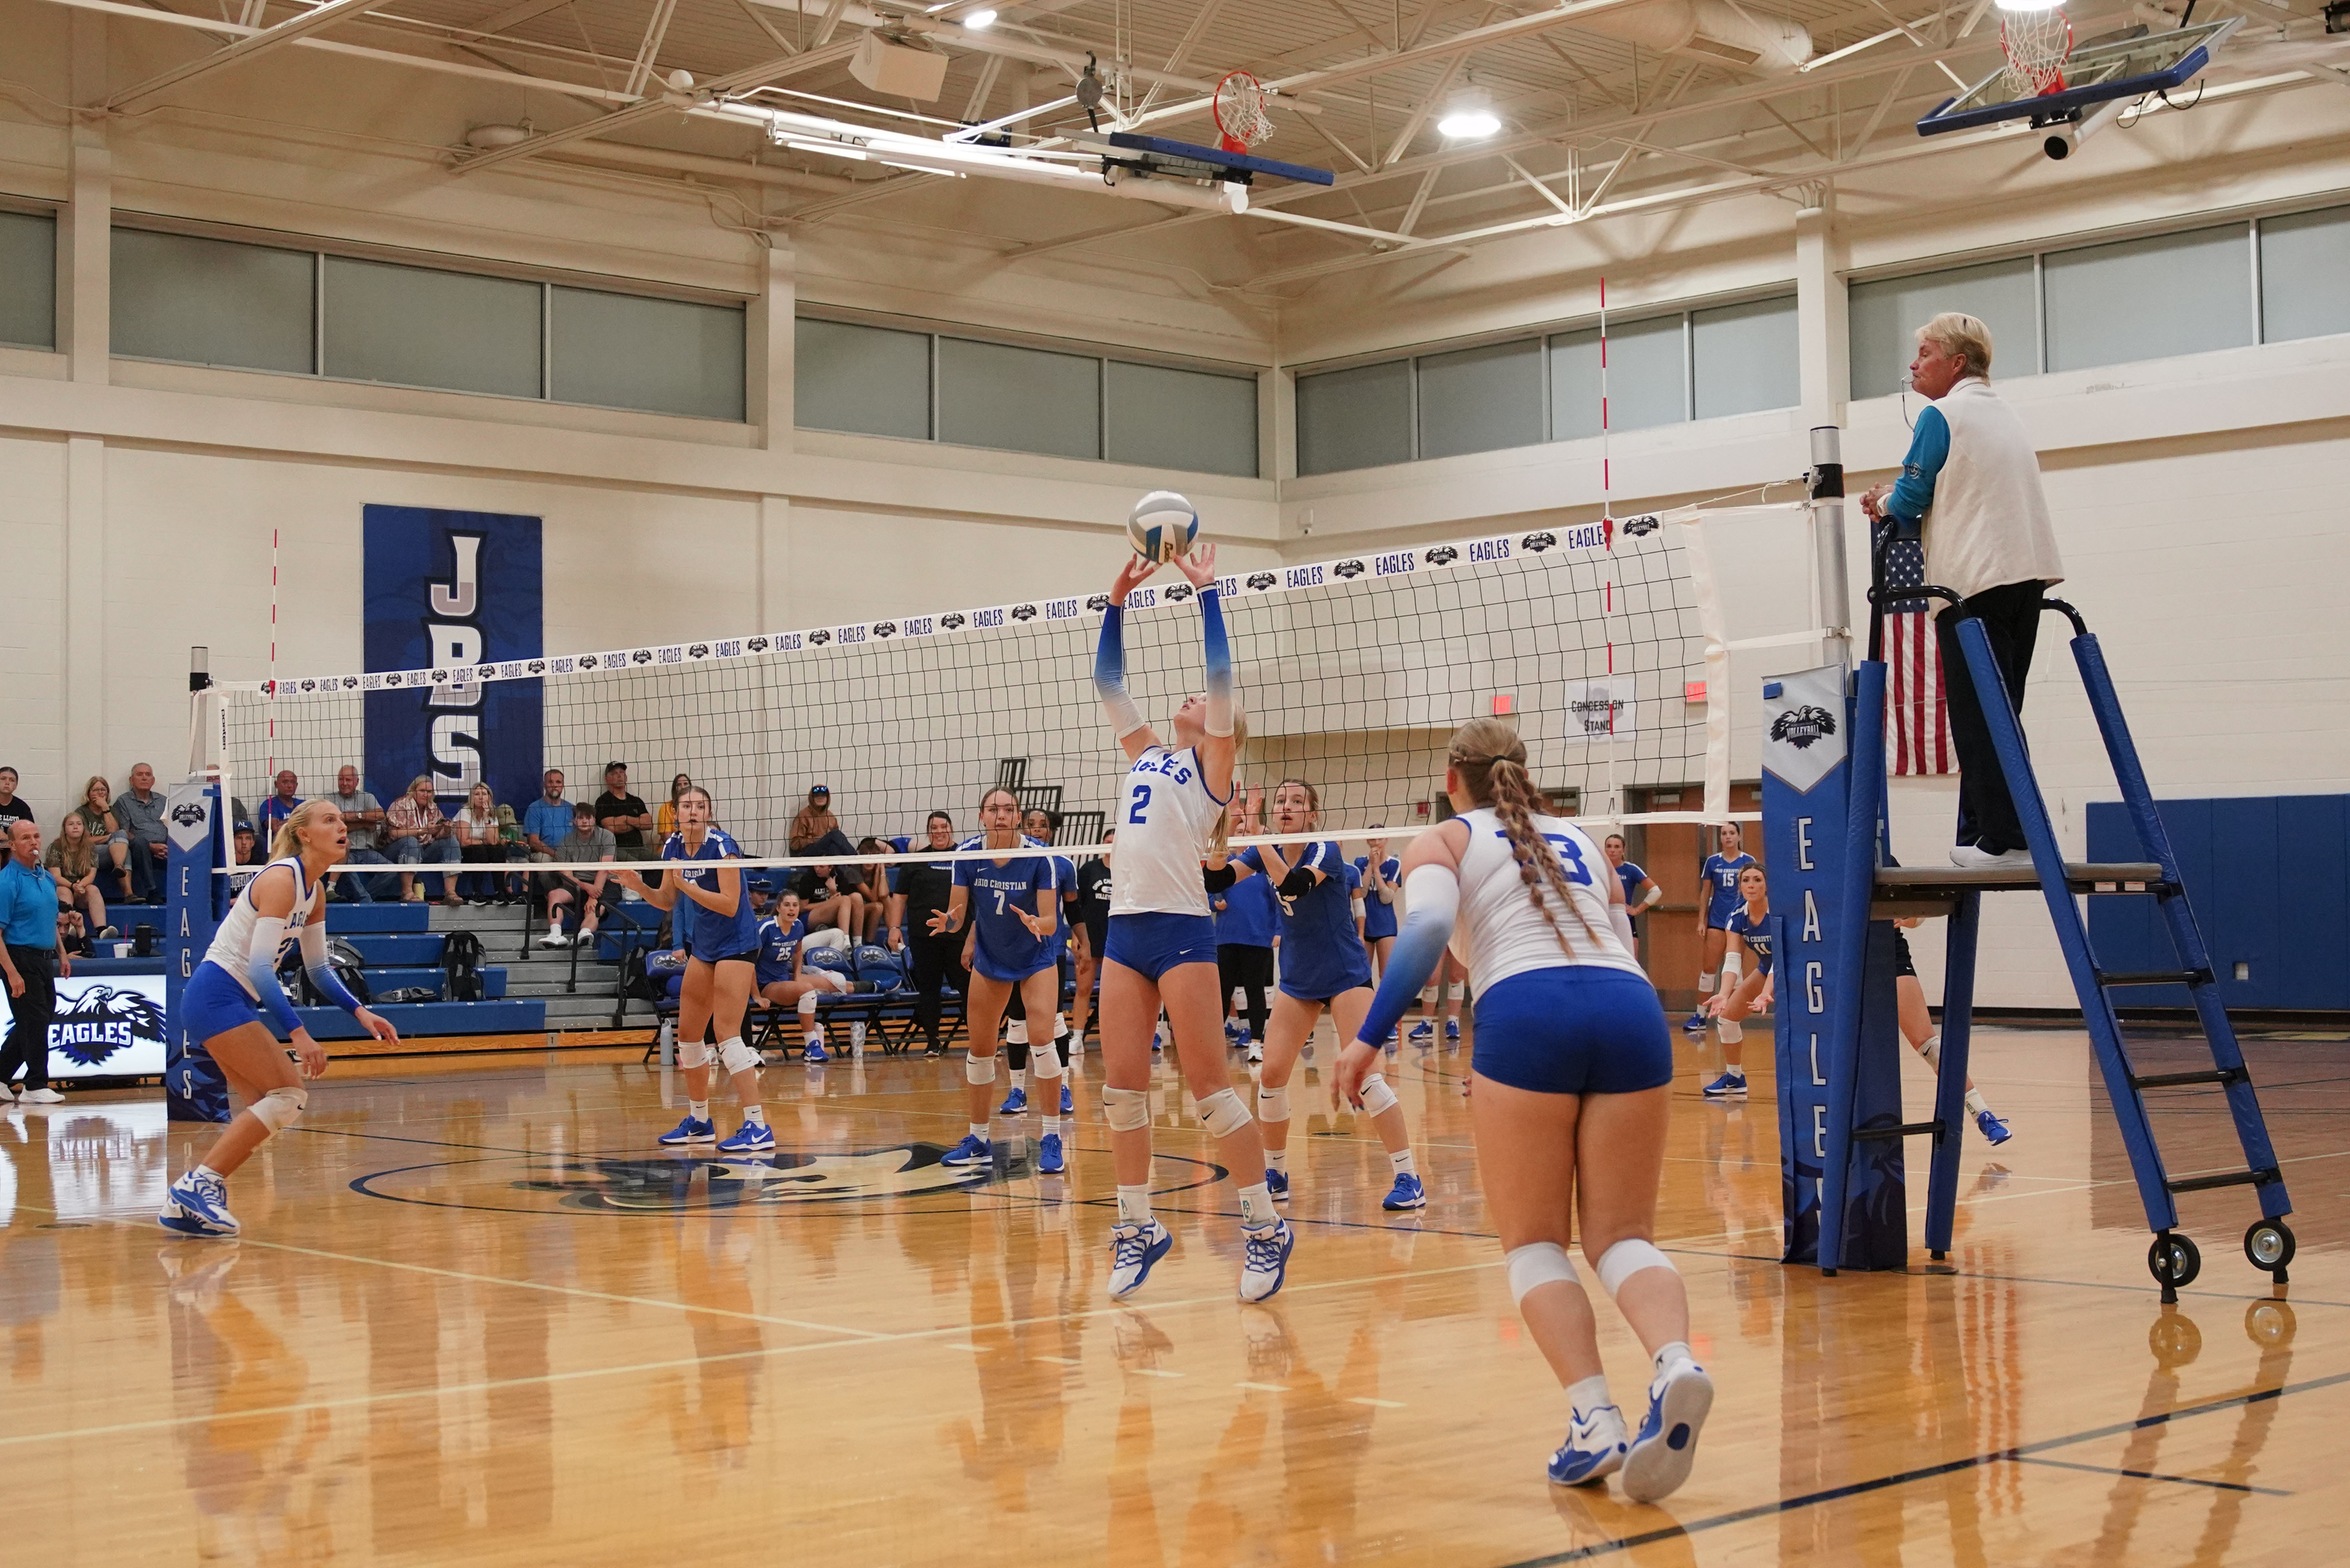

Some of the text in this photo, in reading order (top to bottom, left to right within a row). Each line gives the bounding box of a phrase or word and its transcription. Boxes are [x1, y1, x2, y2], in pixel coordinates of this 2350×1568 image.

[279, 681, 297, 694] EAGLES
[320, 678, 338, 692] EAGLES
[362, 675, 381, 689] EAGLES
[406, 672, 426, 686] EAGLES
[453, 668, 473, 682] EAGLES
[501, 663, 522, 678] EAGLES
[551, 658, 573, 673] EAGLES
[603, 653, 626, 669] EAGLES
[658, 647, 682, 663] EAGLES
[715, 641, 741, 658] EAGLES
[775, 633, 801, 651] EAGLES
[838, 626, 865, 644] EAGLES
[904, 618, 932, 636] EAGLES
[973, 609, 1003, 628] EAGLES
[1046, 600, 1077, 620] EAGLES
[1216, 578, 1238, 597] GLES
[1287, 566, 1323, 588] EAGLES
[1376, 553, 1415, 576] EAGLES
[1469, 538, 1510, 562] EAGLES
[1568, 525, 1607, 549] EAGLE
[429, 535, 483, 797] JBS
[1571, 699, 1624, 712] CONCESSON
[1129, 784, 1152, 825] 2
[990, 880, 1027, 890] CHRISTIAN
[1722, 873, 1735, 887] 15
[993, 890, 1006, 915] 7
[775, 946, 792, 962] 25
[180, 866, 193, 1101] EAGES
[47, 1021, 133, 1048] EAGLES
